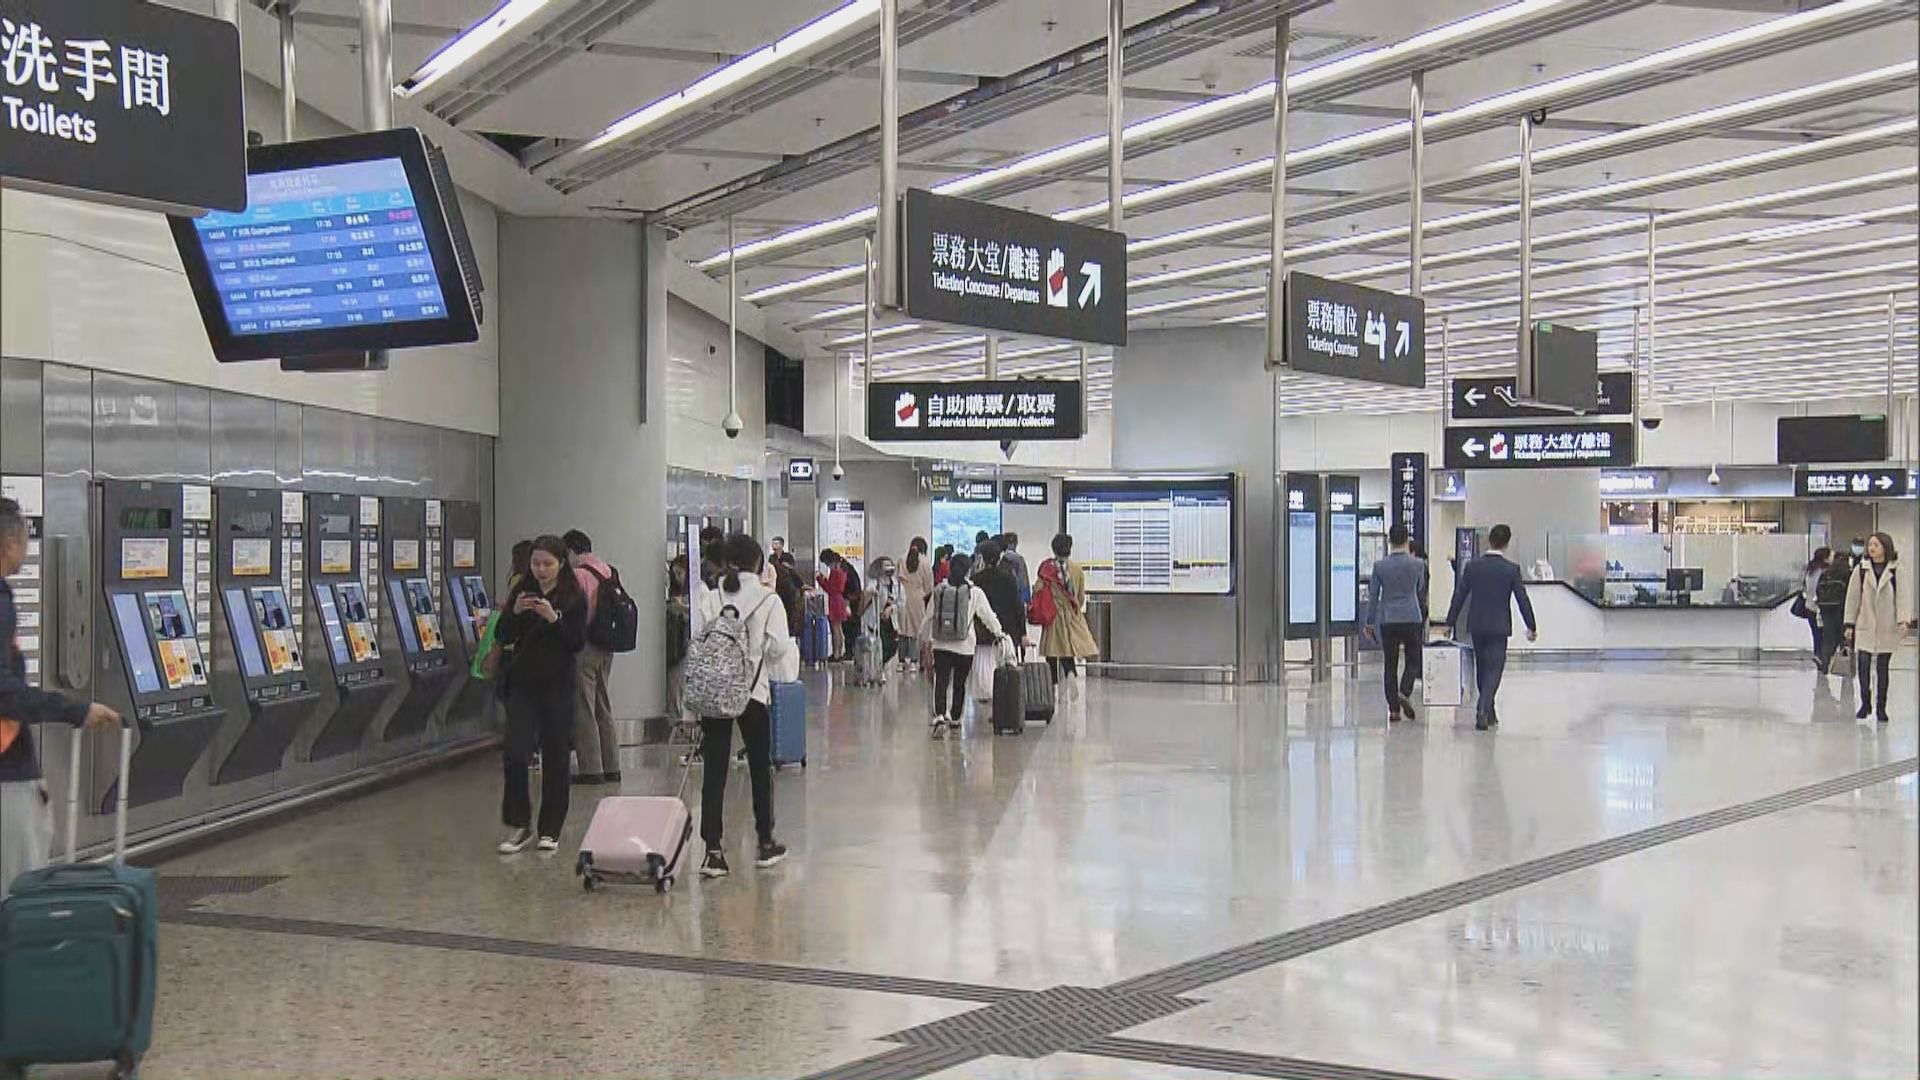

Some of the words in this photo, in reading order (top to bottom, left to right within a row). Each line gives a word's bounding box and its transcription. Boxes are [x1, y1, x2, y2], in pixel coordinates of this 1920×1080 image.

[2, 17, 170, 116] 洗手間
[3, 97, 96, 143] Toilets
[933, 232, 1040, 281] 票務大堂/離港
[933, 272, 965, 296] Ticketing
[965, 277, 1000, 298] Concourse
[1005, 283, 1040, 304] Departures
[1307, 335, 1333, 357] Ticketing
[1334, 340, 1358, 357] Counters
[928, 393, 1056, 415] 自助購票/取票
[928, 416, 966, 428] Self-service
[967, 416, 986, 427] ticket
[987, 416, 1017, 429] purchase
[1021, 416, 1055, 427] collection
